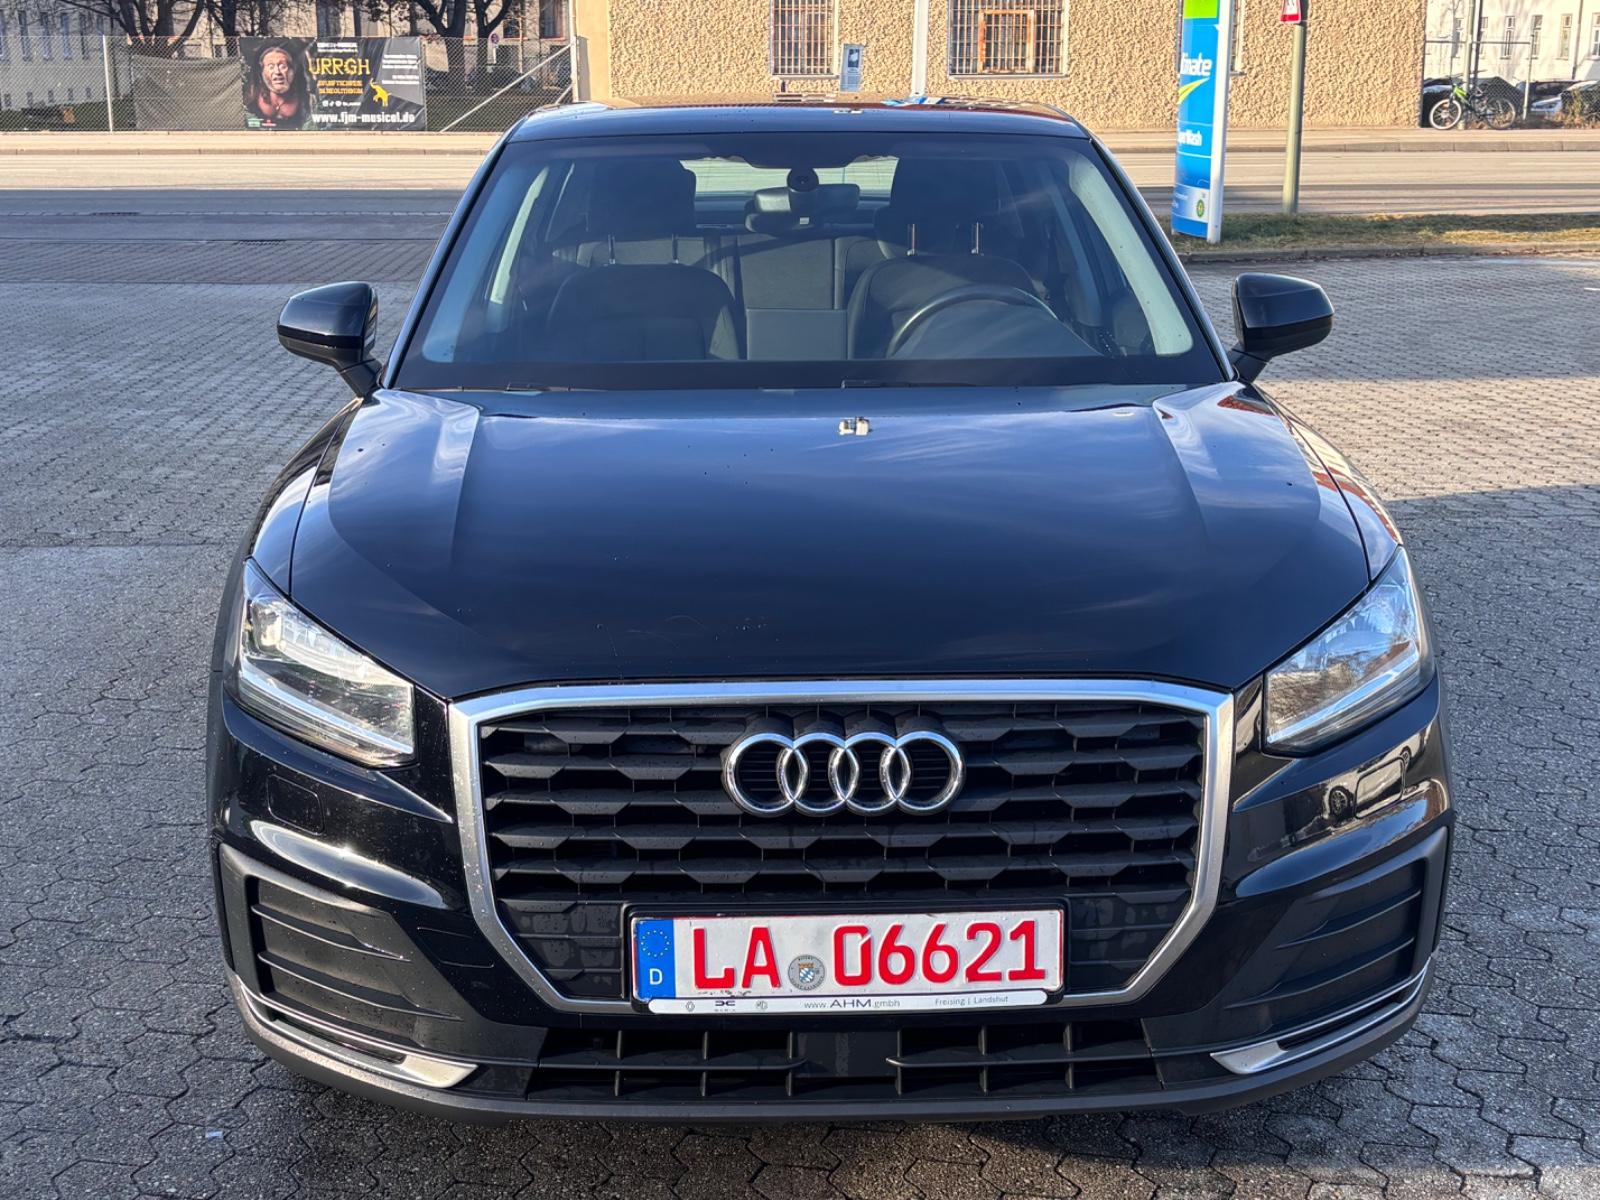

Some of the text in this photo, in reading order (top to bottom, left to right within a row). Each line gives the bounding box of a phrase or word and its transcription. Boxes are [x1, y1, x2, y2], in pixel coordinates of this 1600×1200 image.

[308, 57, 371, 75] URRGH
[693, 926, 782, 990] LA
[833, 920, 1046, 986] 06621
[649, 968, 663, 985] D
[934, 998, 966, 1008] Freising
[973, 995, 1008, 1005] Landshut
